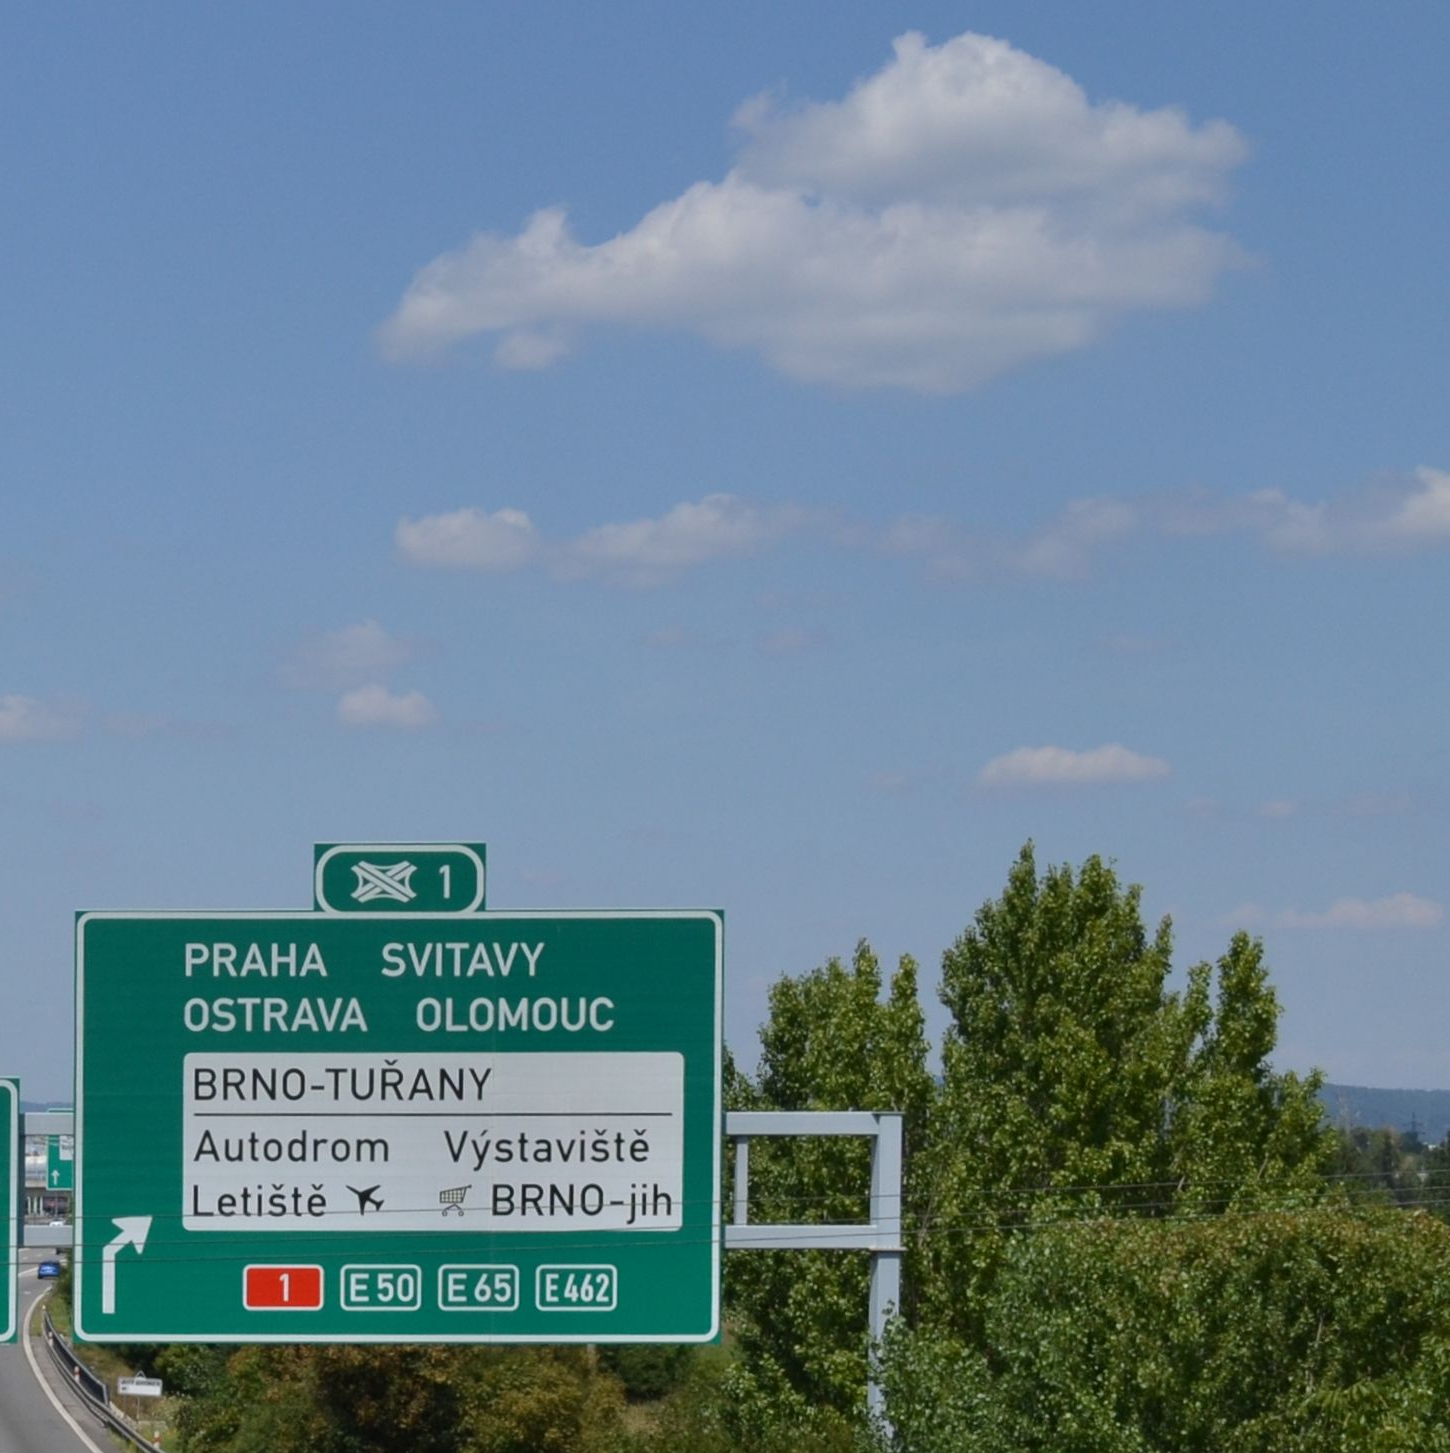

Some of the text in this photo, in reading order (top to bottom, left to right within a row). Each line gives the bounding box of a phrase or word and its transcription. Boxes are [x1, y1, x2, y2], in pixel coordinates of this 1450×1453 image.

[438, 865, 451, 898] 1
[184, 942, 545, 977] PRAHA SVITAVY
[183, 997, 614, 1032] OSTRAVA OLOMOUC
[193, 1059, 492, 1101] BRNO-TUŘANY
[193, 1128, 650, 1171] Autodrom Výstaviště
[192, 1183, 672, 1224] Letiště BRNO-jih
[278, 1273, 290, 1302] 1
